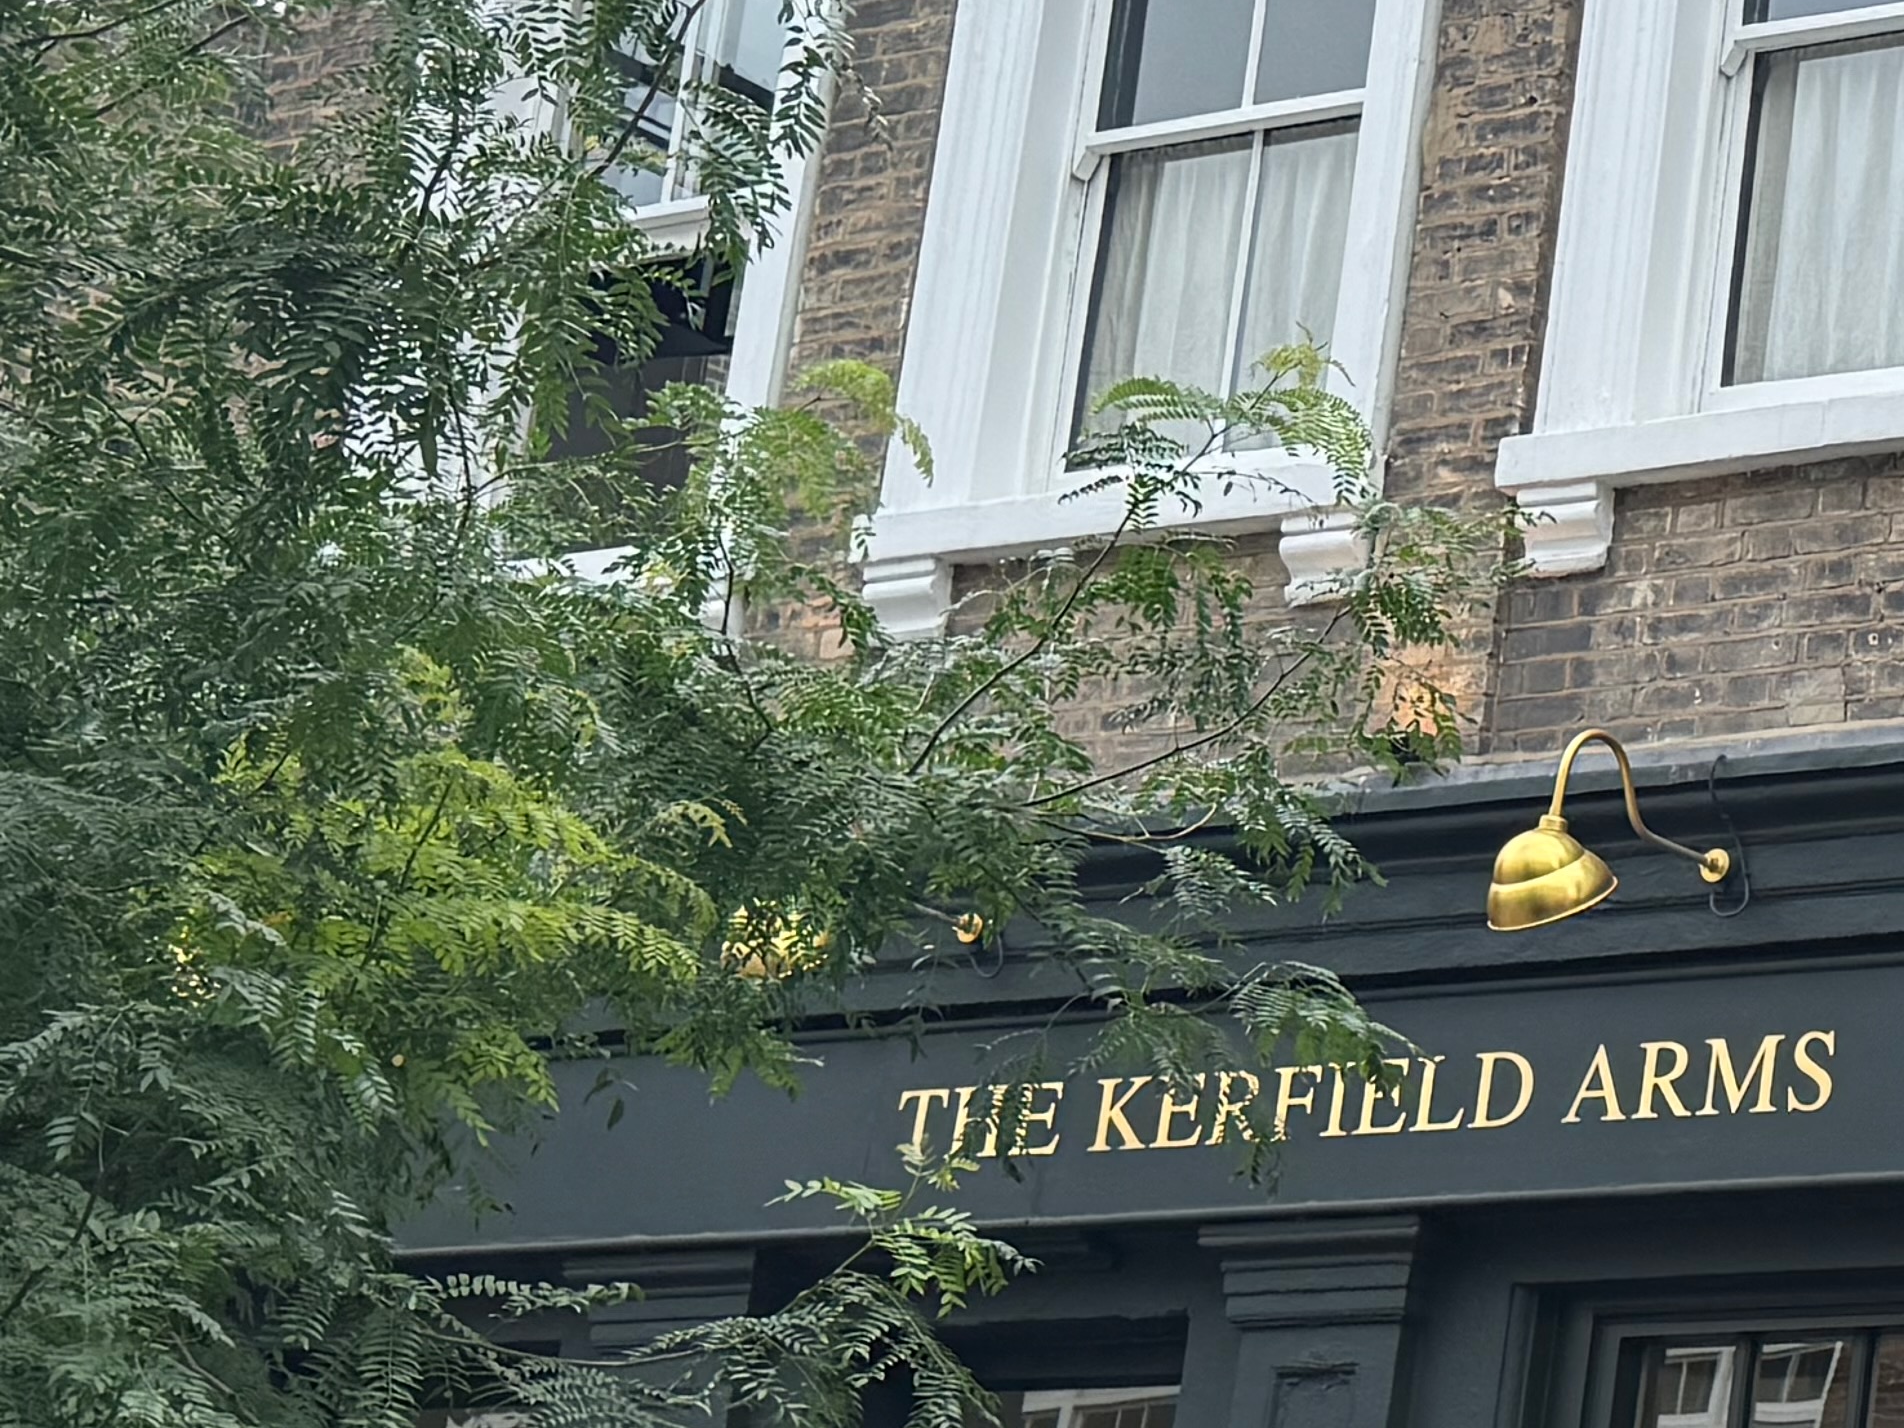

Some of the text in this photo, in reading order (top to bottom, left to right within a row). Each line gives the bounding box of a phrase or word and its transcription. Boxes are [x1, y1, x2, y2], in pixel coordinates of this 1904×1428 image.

[899, 1028, 1837, 1160] THE KERFIELD ARMS
